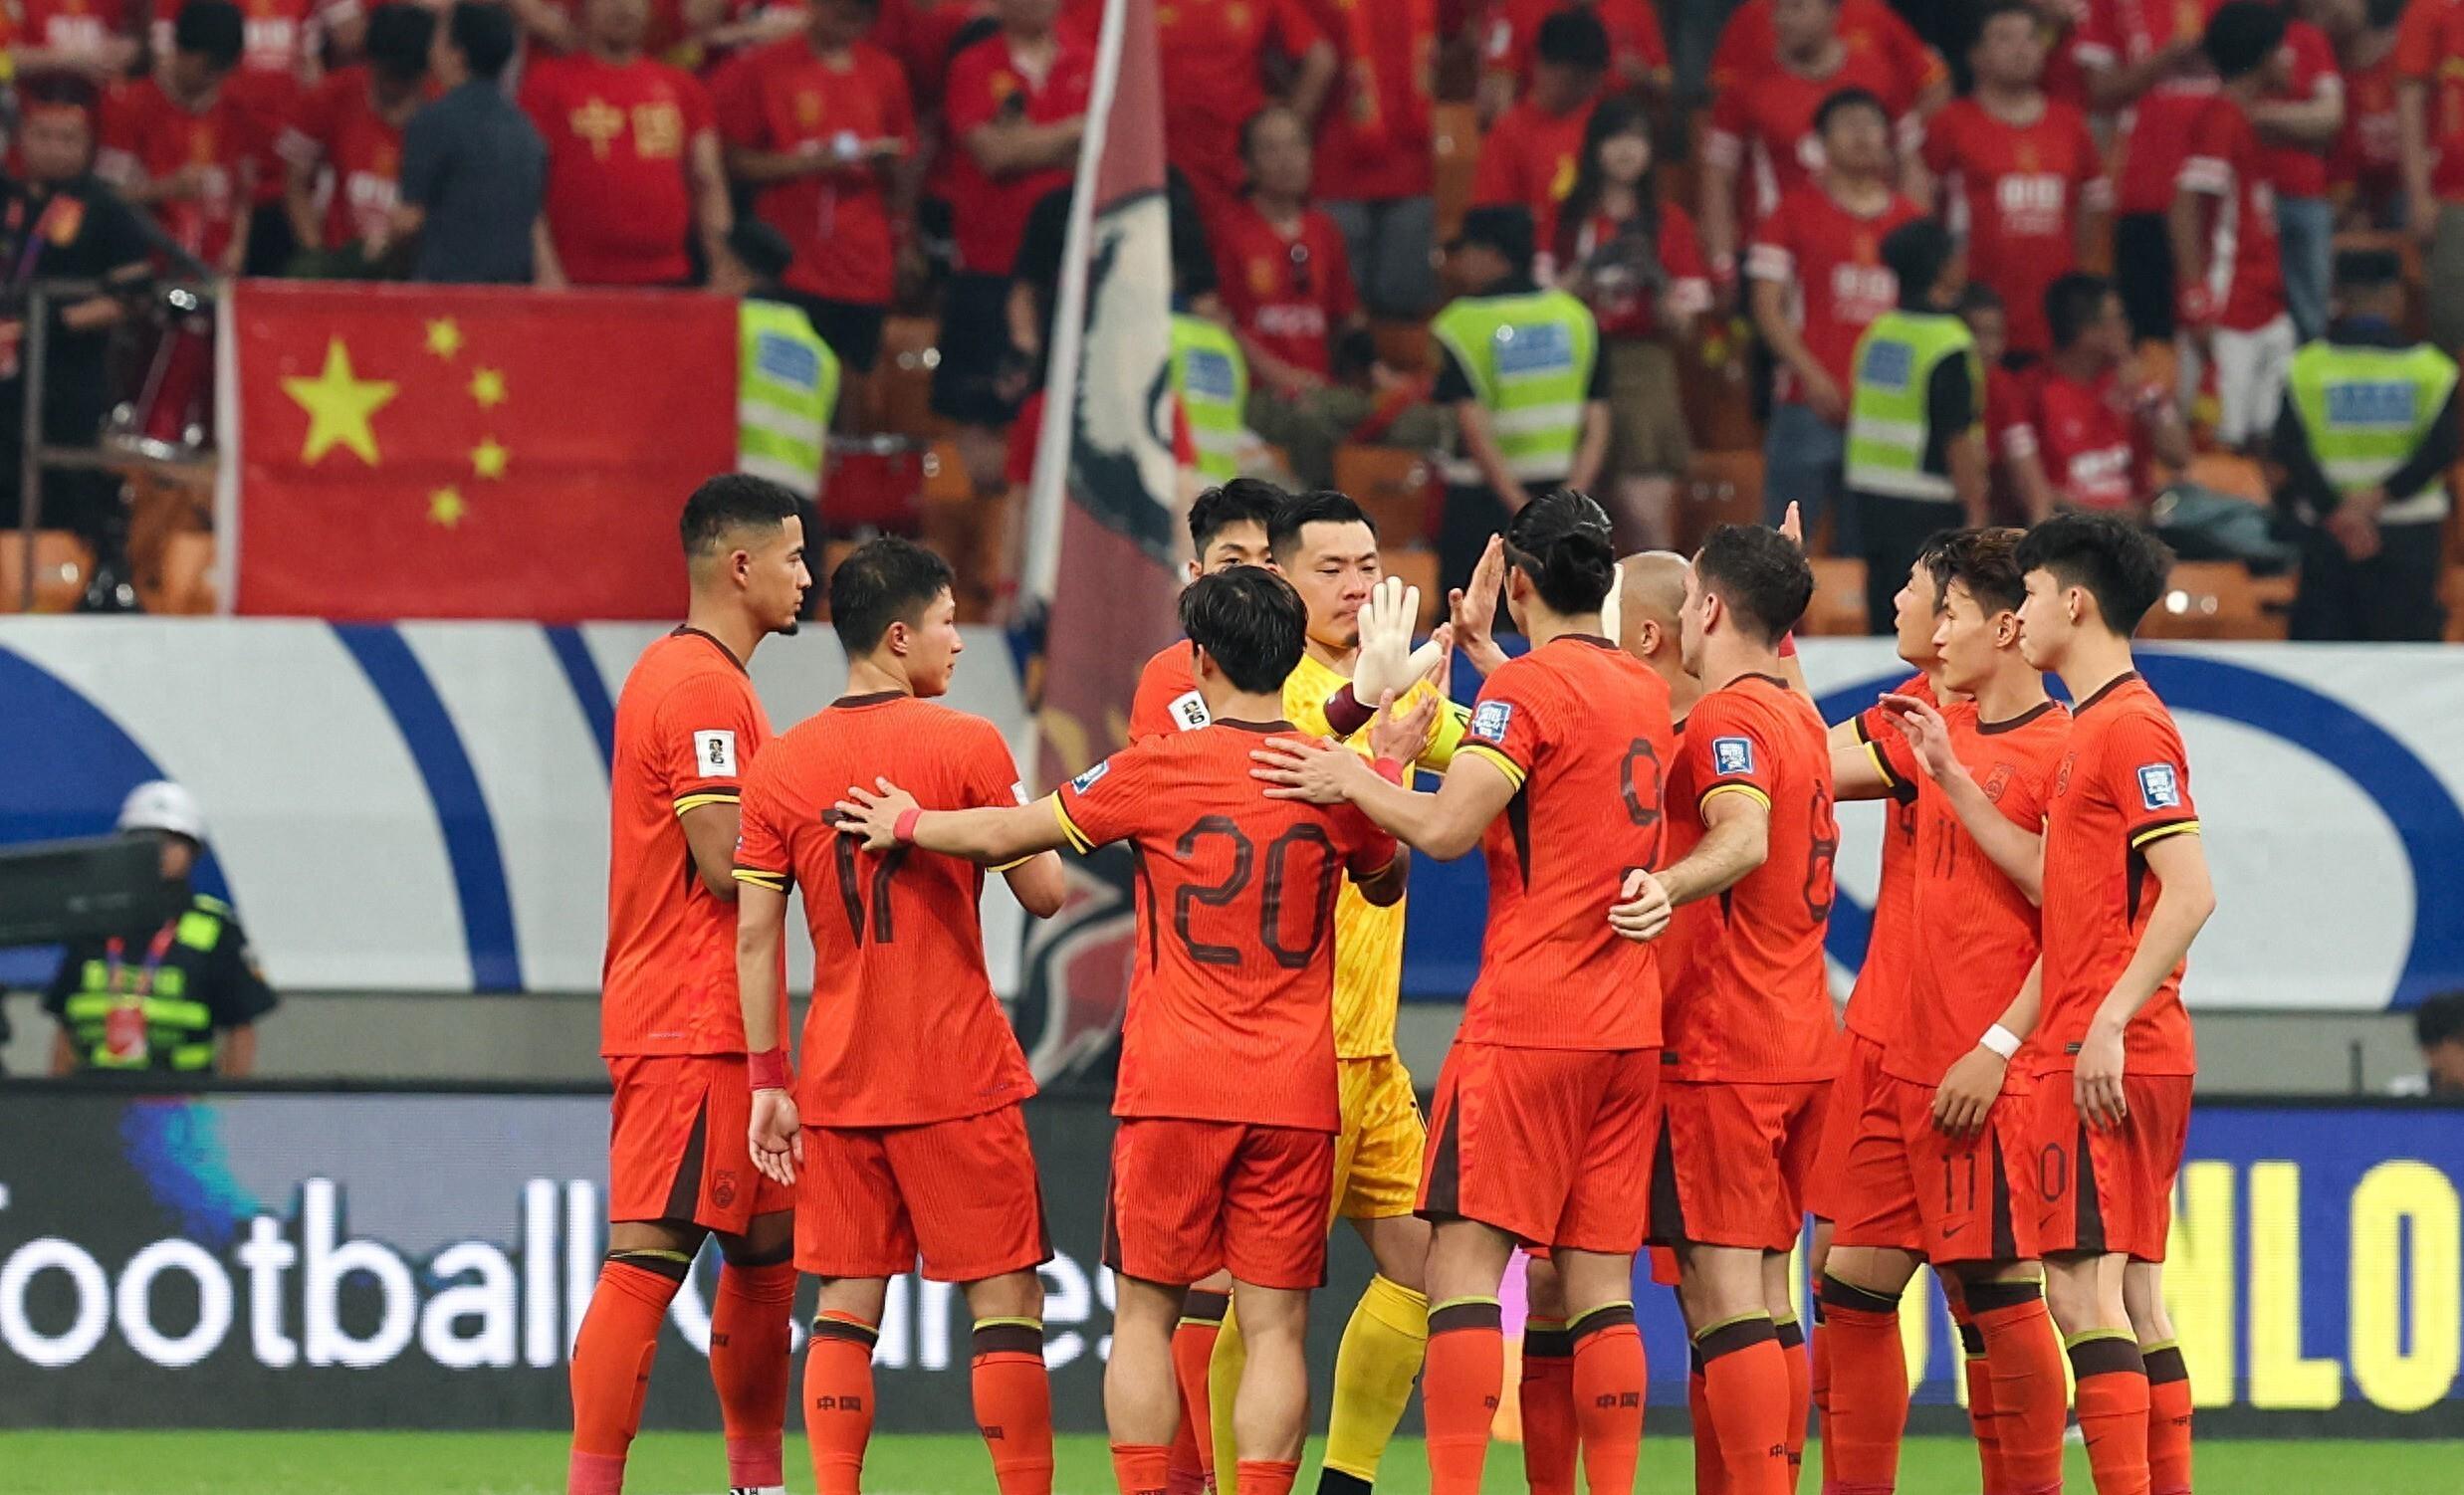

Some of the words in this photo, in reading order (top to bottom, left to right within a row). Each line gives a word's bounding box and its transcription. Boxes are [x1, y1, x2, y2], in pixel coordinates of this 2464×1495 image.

[569, 97, 681, 158] 中国
[1620, 737, 1662, 882] 9
[1803, 778, 1838, 923] 8
[1933, 818, 1956, 880] 11
[1174, 815, 1335, 969] 20
[1941, 1153, 1975, 1213] 11
[0, 1176, 596, 1368] ootball
[817, 1395, 861, 1411] 中国
[1596, 1391, 1640, 1408] 中国
